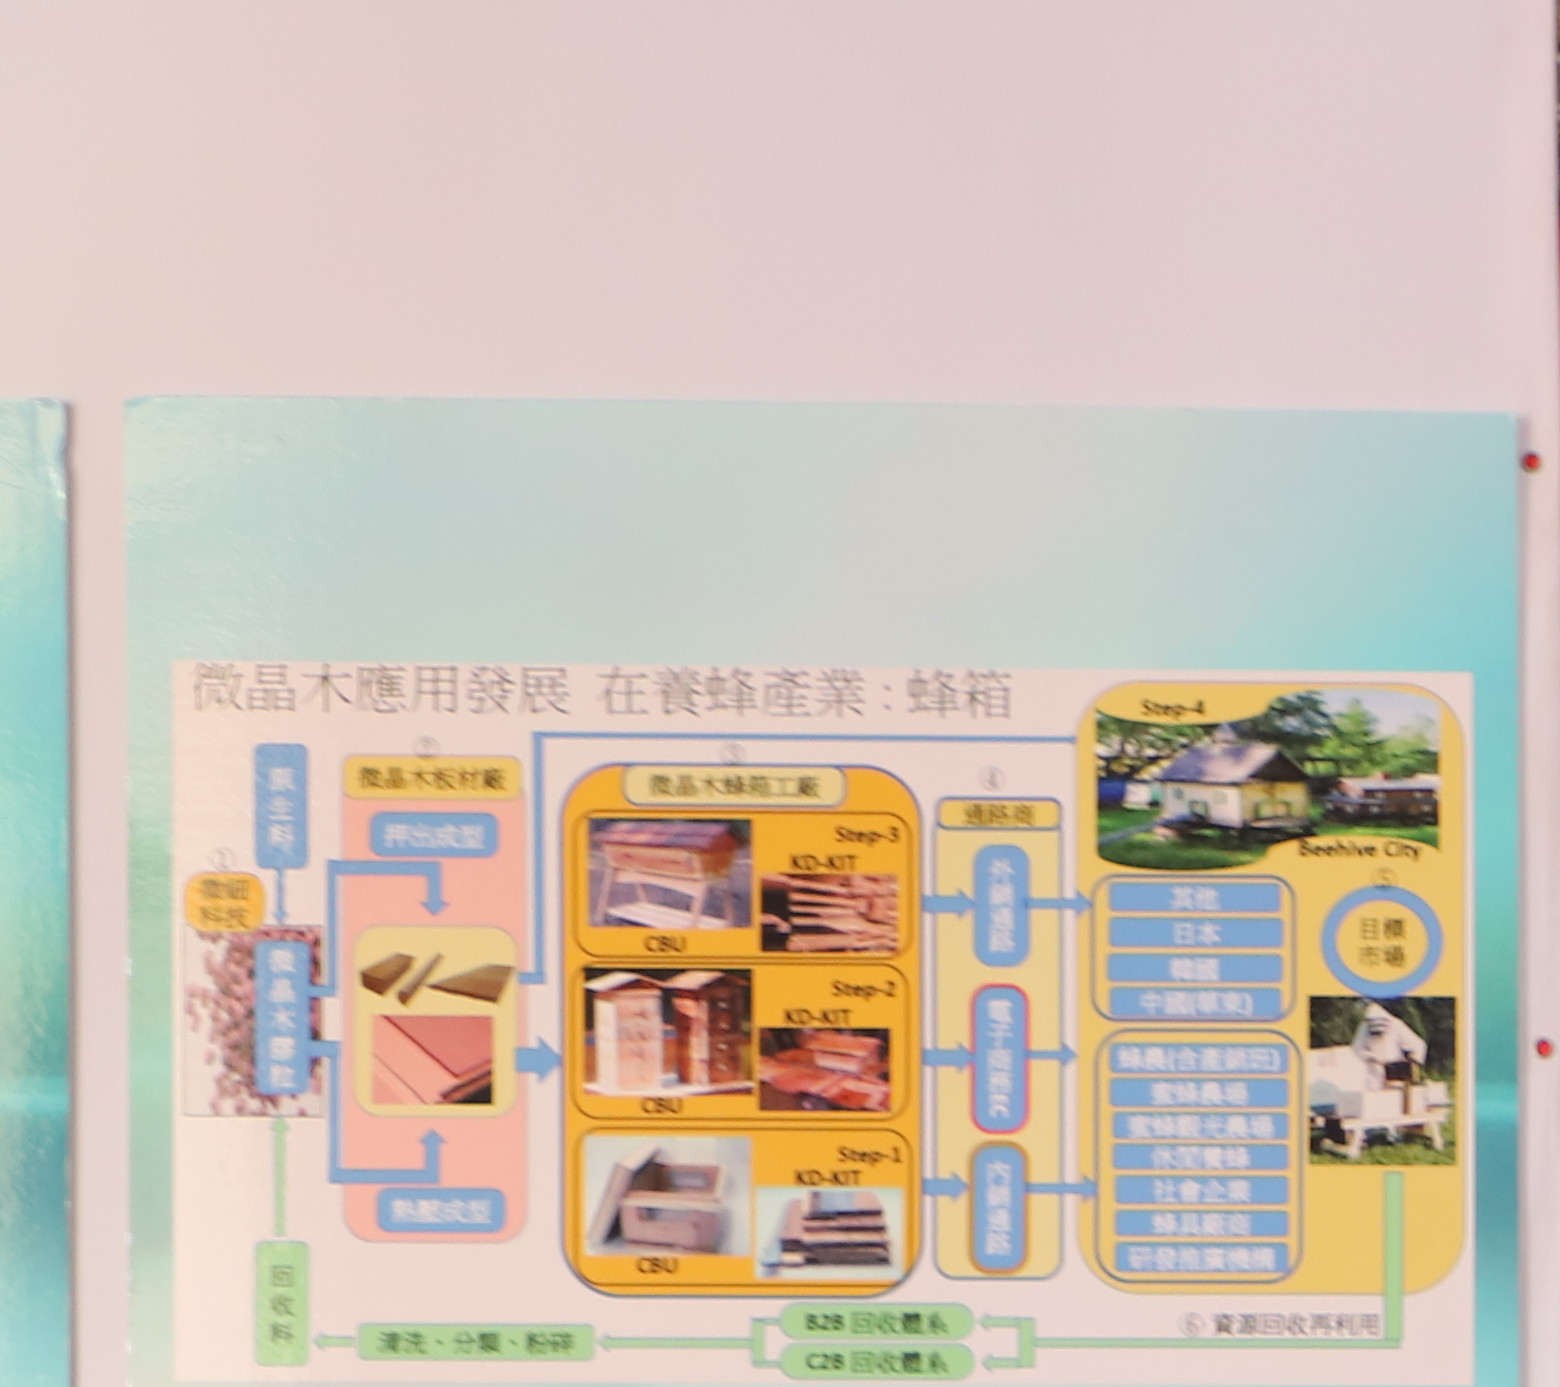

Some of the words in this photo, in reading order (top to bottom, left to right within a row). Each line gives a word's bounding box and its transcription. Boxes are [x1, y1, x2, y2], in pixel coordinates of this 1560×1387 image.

[192, 662, 571, 715] 微晶木應用發展
[1141, 697, 1206, 720] Step-4
[834, 826, 899, 846] Step-3
[1298, 839, 1378, 859] Beehive
[1384, 839, 1423, 861] City
[789, 854, 857, 872] KD-KIT
[1170, 886, 1221, 911] 其他
[1173, 922, 1223, 946] 日本
[643, 935, 687, 953] CBU
[832, 980, 896, 1000] Step-2
[784, 1009, 852, 1026] KD-KIT
[641, 1097, 684, 1115] CBU
[837, 1146, 904, 1164] Step-1
[794, 1170, 862, 1187] KD-KIT
[635, 1257, 679, 1274] CBU
[804, 1313, 846, 1331] B2B
[804, 1353, 846, 1370] C2B
